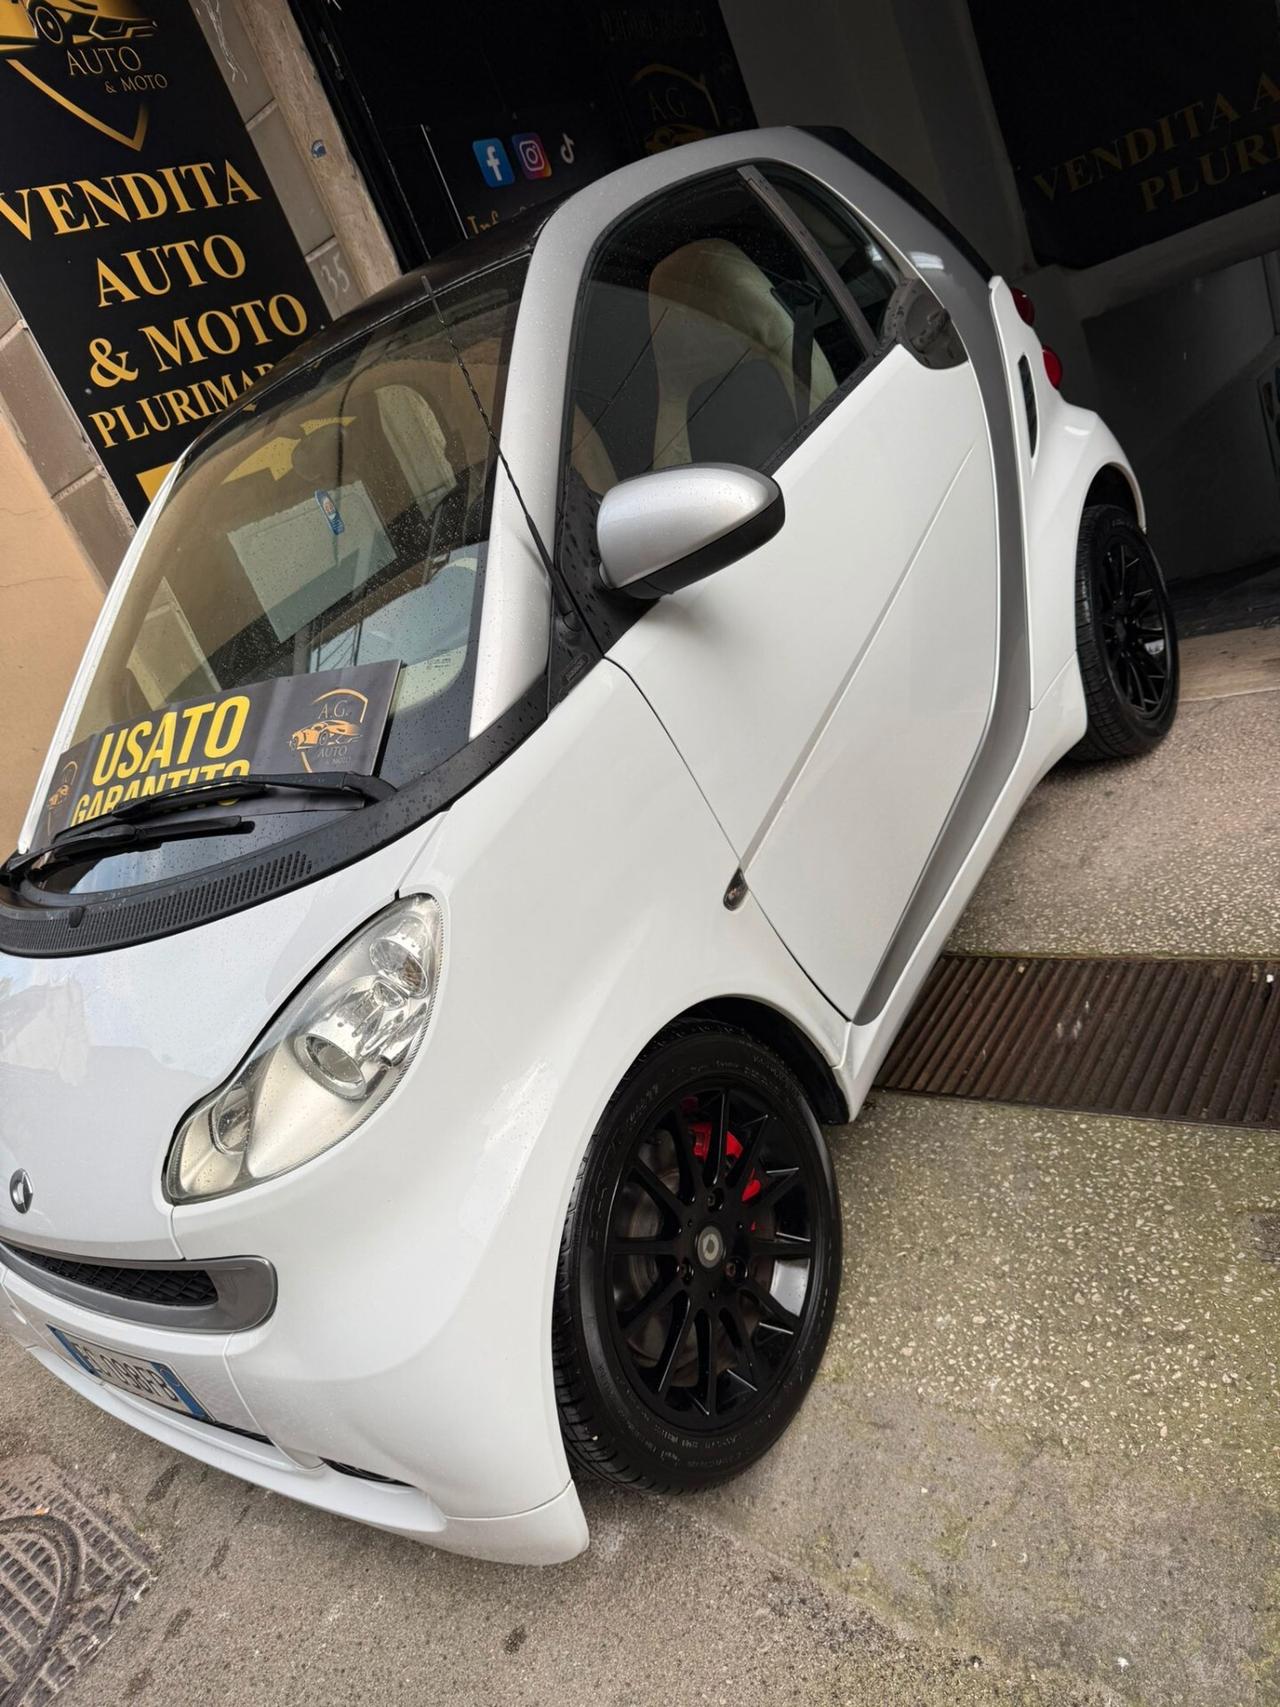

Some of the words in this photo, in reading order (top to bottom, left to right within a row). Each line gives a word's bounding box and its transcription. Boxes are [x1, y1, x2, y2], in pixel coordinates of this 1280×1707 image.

[66, 45, 142, 77] AUTO
[105, 80, 116, 94] &
[121, 72, 168, 92] MOTO
[1033, 92, 1243, 202] VENDITA
[0, 159, 262, 241] VENDITA
[97, 233, 247, 308] AUTO
[88, 337, 139, 388] &
[138, 293, 308, 373] MOTO
[92, 695, 251, 787] USATO
